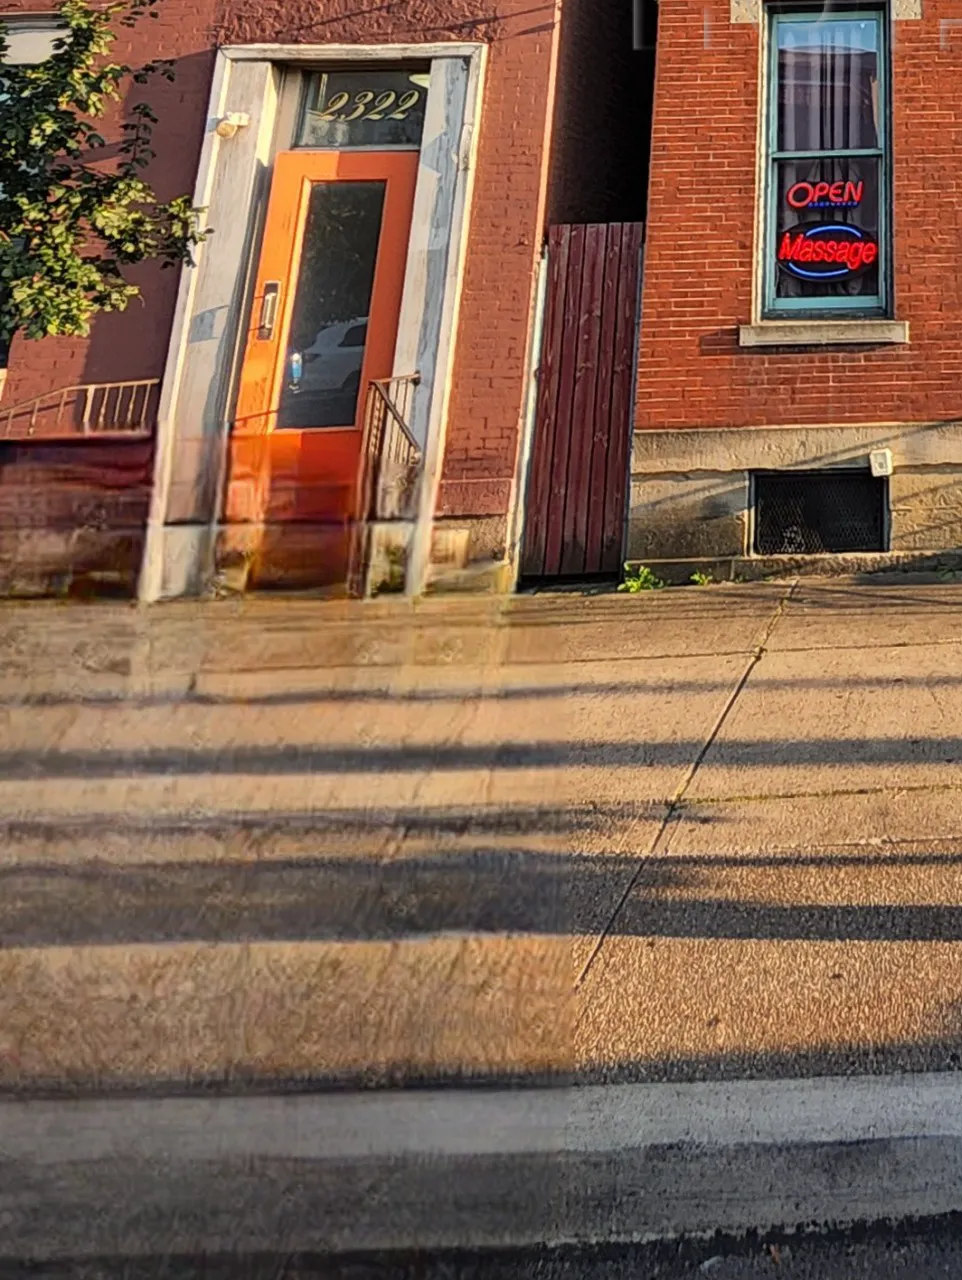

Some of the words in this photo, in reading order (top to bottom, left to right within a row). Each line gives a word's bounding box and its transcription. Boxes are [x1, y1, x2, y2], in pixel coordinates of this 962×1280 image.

[319, 89, 421, 121] 2322
[787, 180, 864, 208] OPEN
[778, 232, 878, 270] Massage
